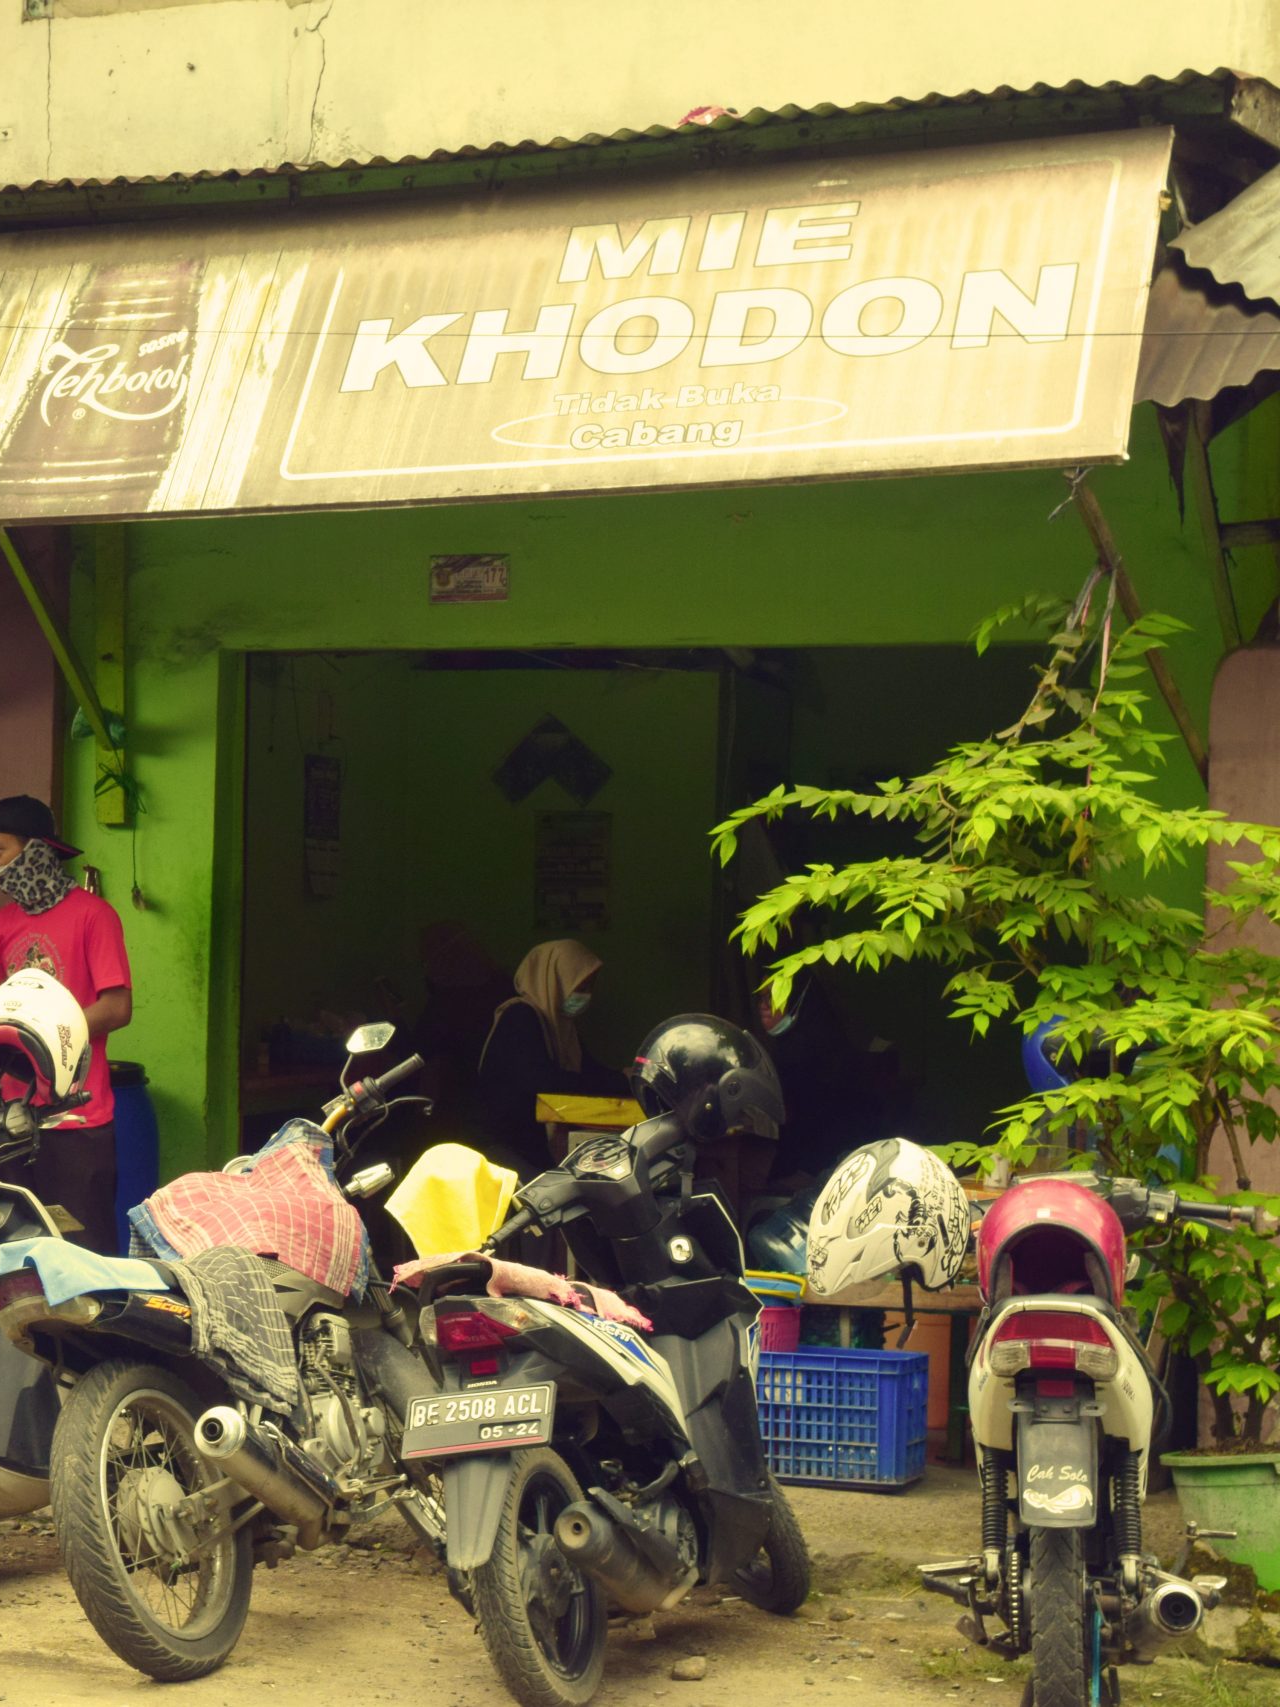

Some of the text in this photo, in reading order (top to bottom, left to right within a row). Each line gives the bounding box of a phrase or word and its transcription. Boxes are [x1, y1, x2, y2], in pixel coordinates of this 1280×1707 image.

[556, 201, 862, 284] MIE
[338, 263, 1080, 393] KHODON
[553, 382, 781, 416] Tidak Buka
[570, 419, 744, 450] Cabang
[466, 1379, 498, 1389] HONDA
[413, 1393, 542, 1428] BE 2508 ACL
[1026, 1464, 1089, 1483] Cah Solo
